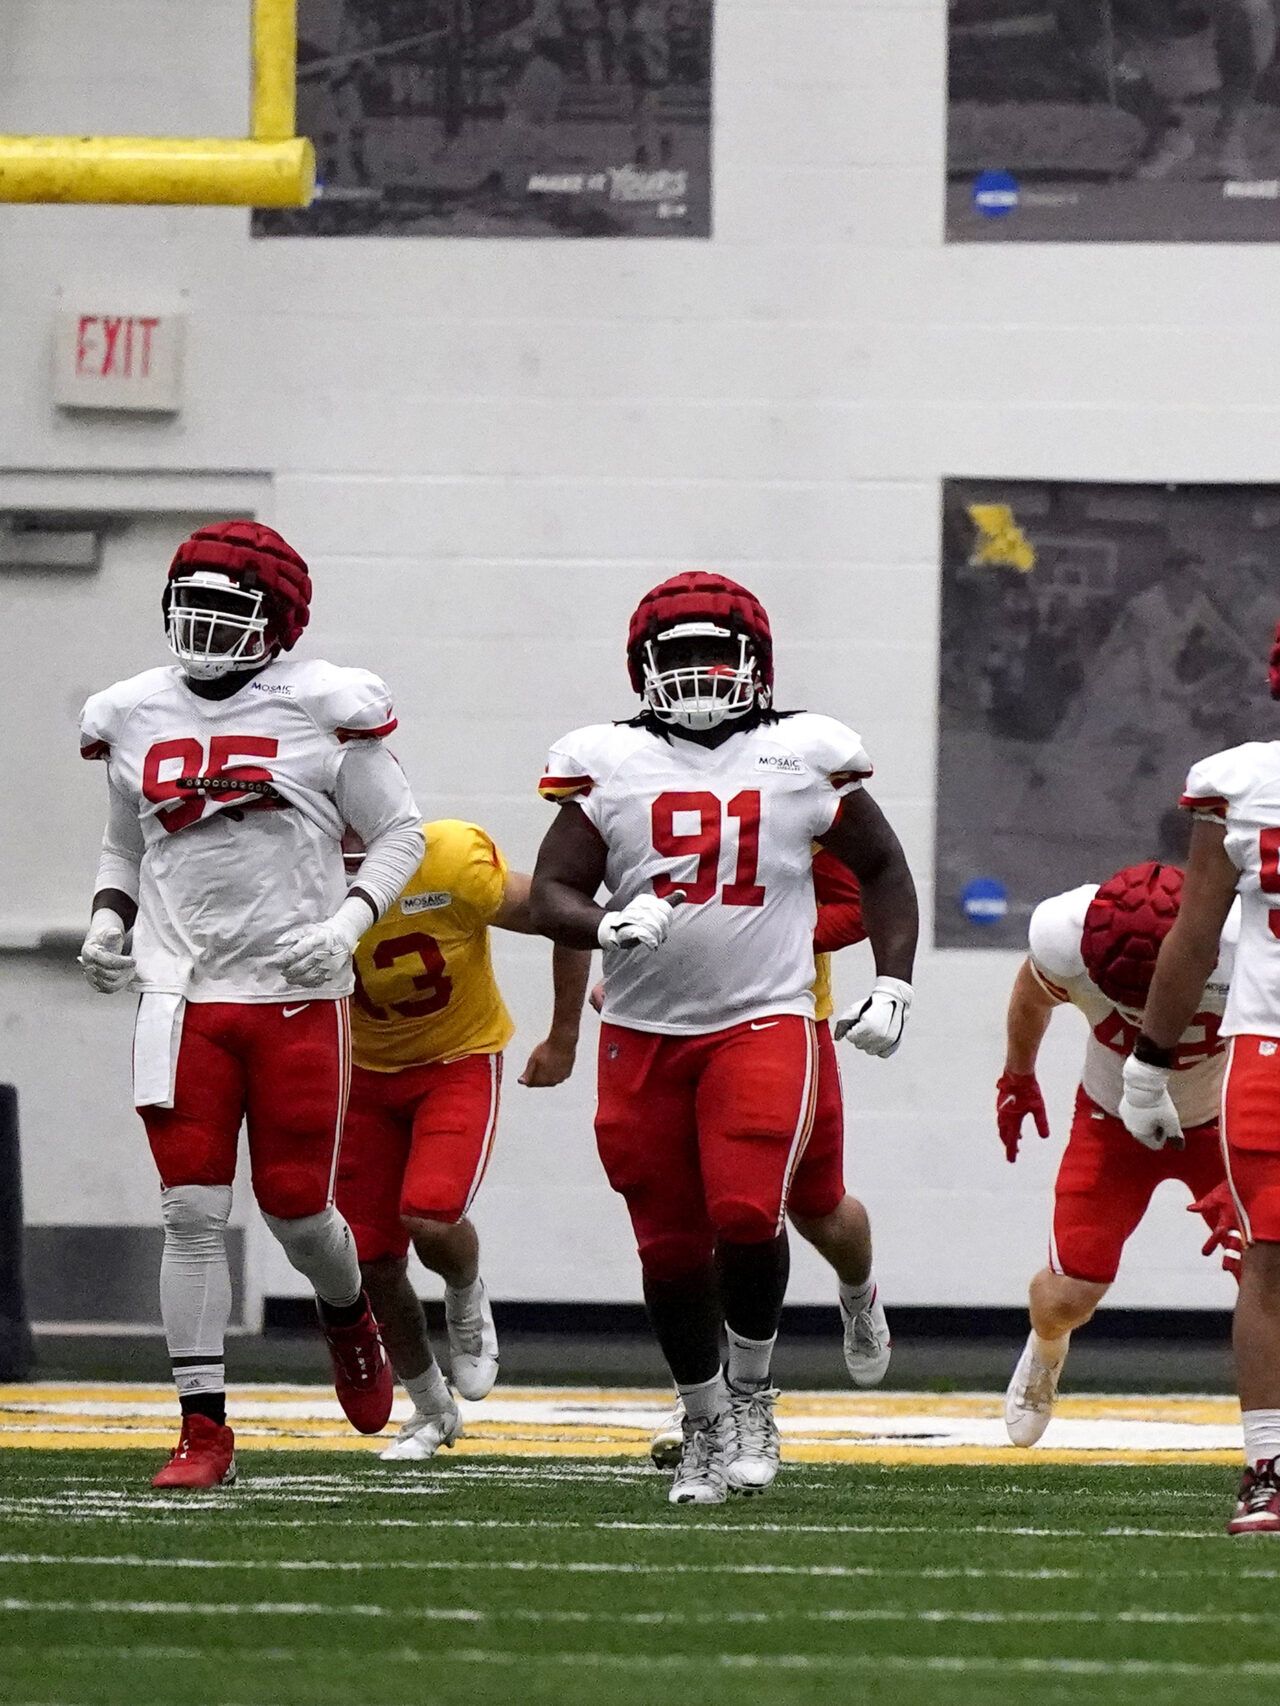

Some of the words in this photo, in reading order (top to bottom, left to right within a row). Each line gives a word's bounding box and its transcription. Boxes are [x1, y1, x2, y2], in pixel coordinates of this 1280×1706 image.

[76, 315, 159, 378] EXIT
[142, 735, 279, 833] 95
[758, 757, 800, 768] MOSAIC
[651, 789, 766, 907] 91
[404, 893, 446, 908] MOSAIC
